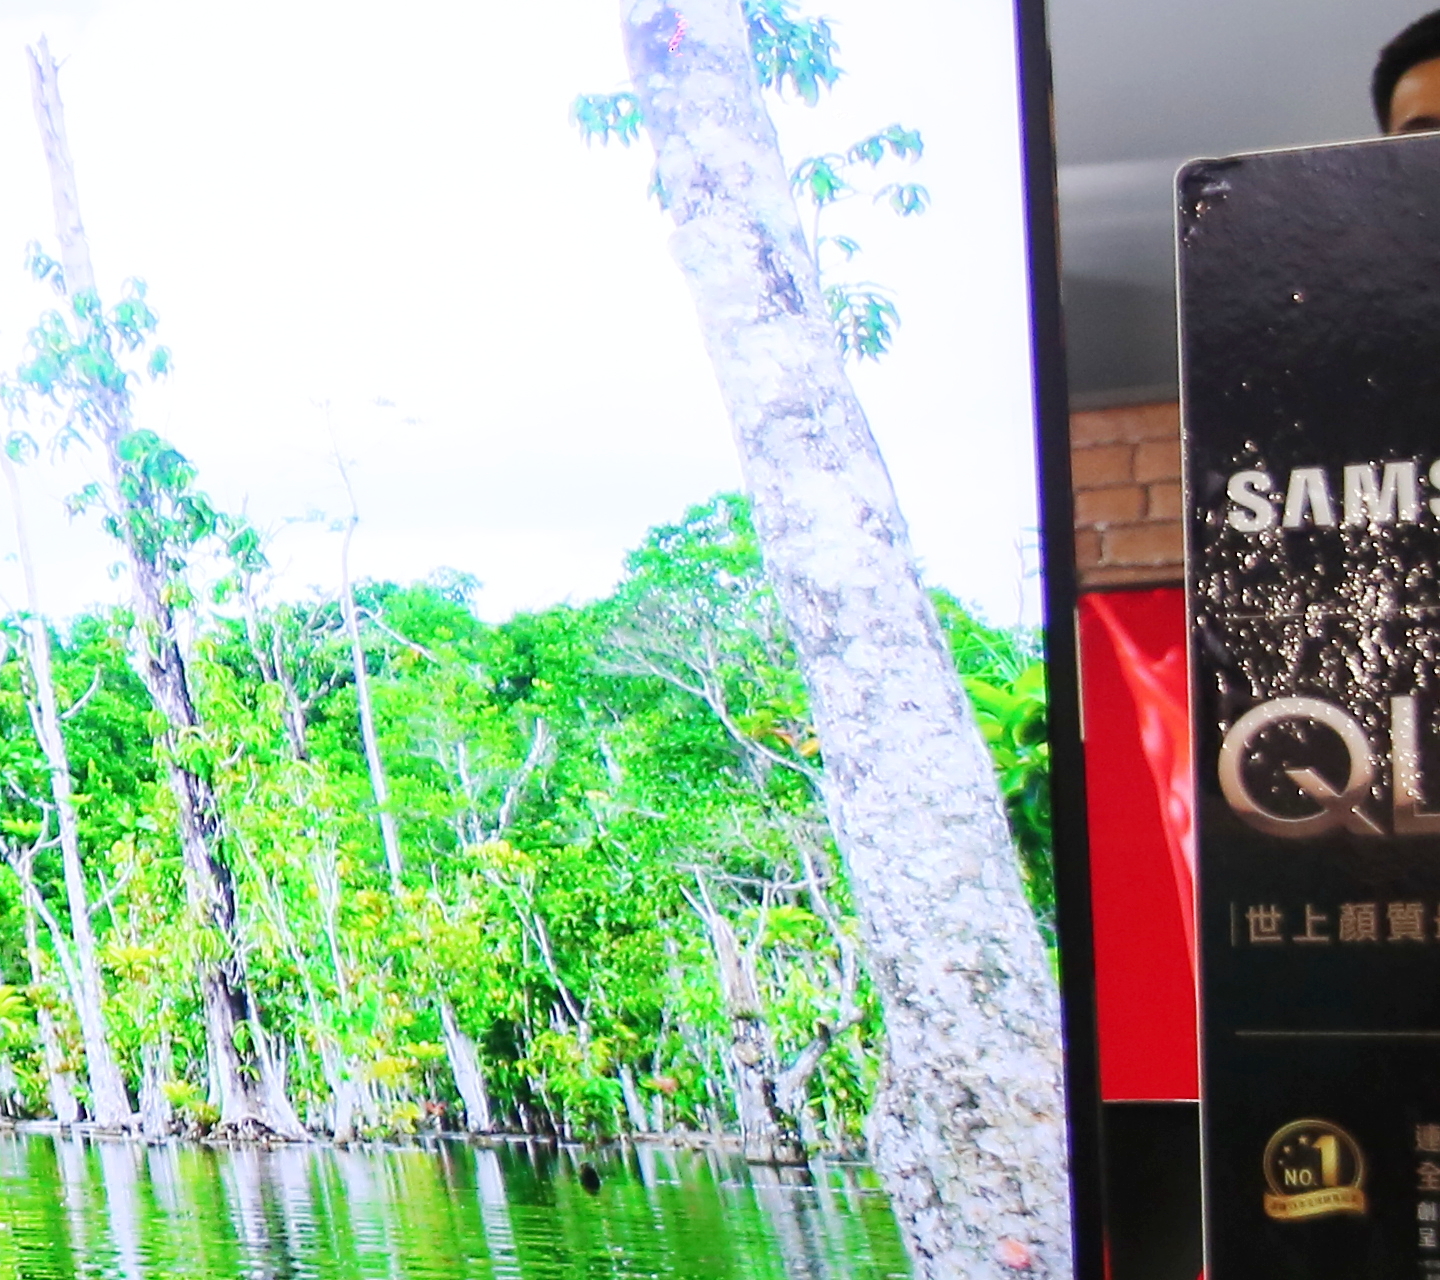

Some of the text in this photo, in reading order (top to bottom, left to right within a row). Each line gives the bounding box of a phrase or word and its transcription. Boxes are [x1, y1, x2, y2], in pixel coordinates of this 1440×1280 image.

[1227, 460, 1440, 533] SAM
[1245, 902, 1440, 943] 世上顏質
[1311, 1135, 1339, 1187] 1
